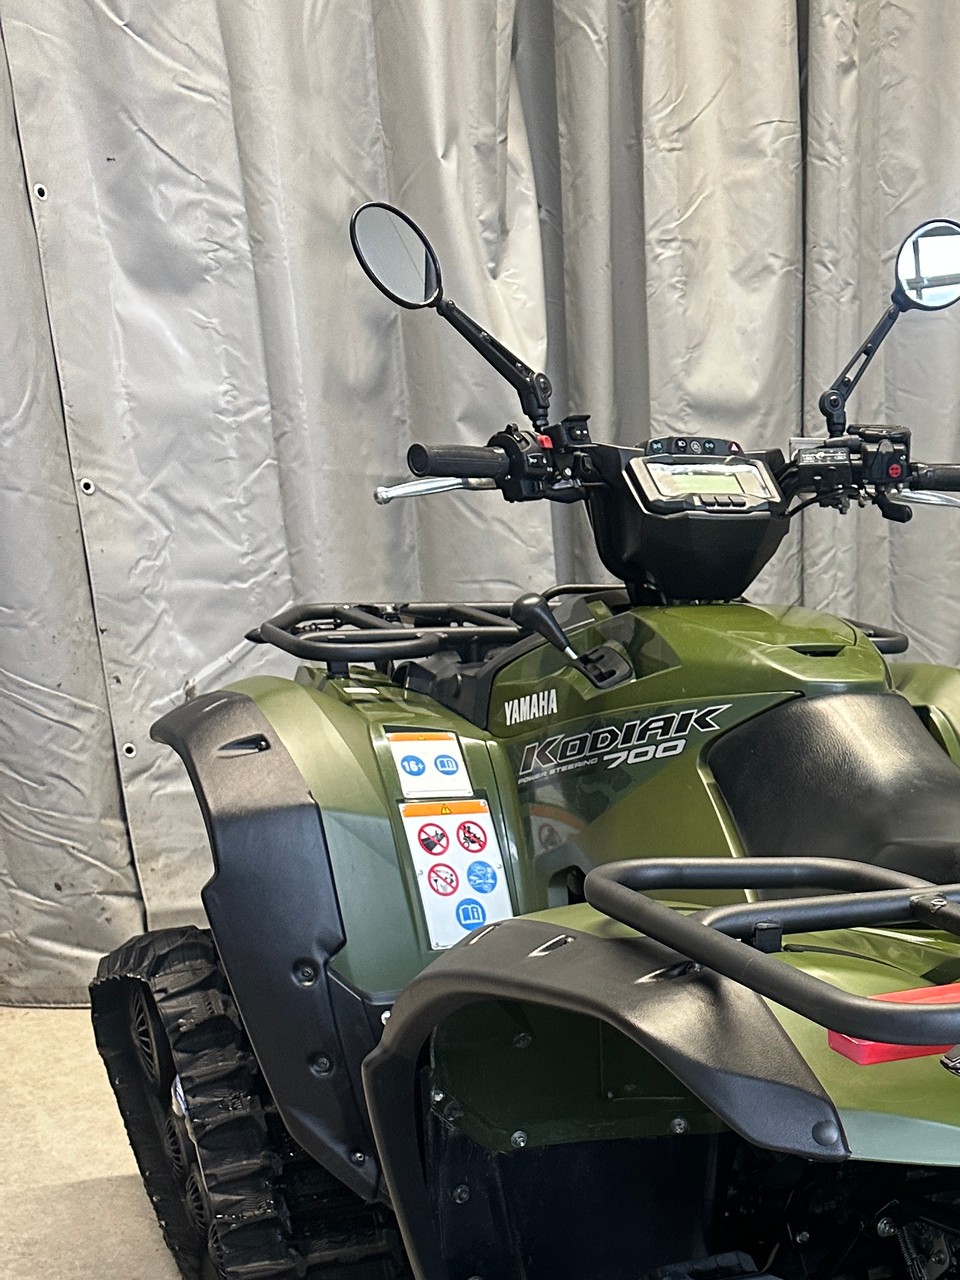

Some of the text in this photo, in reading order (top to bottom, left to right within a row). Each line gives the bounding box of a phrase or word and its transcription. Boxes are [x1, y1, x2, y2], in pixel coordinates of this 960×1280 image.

[504, 688, 558, 726] YAMAHA
[518, 703, 733, 776] KODIAK
[602, 739, 686, 770] 700
[402, 761, 424, 774] 16+
[518, 757, 598, 785] POWER STEERING
